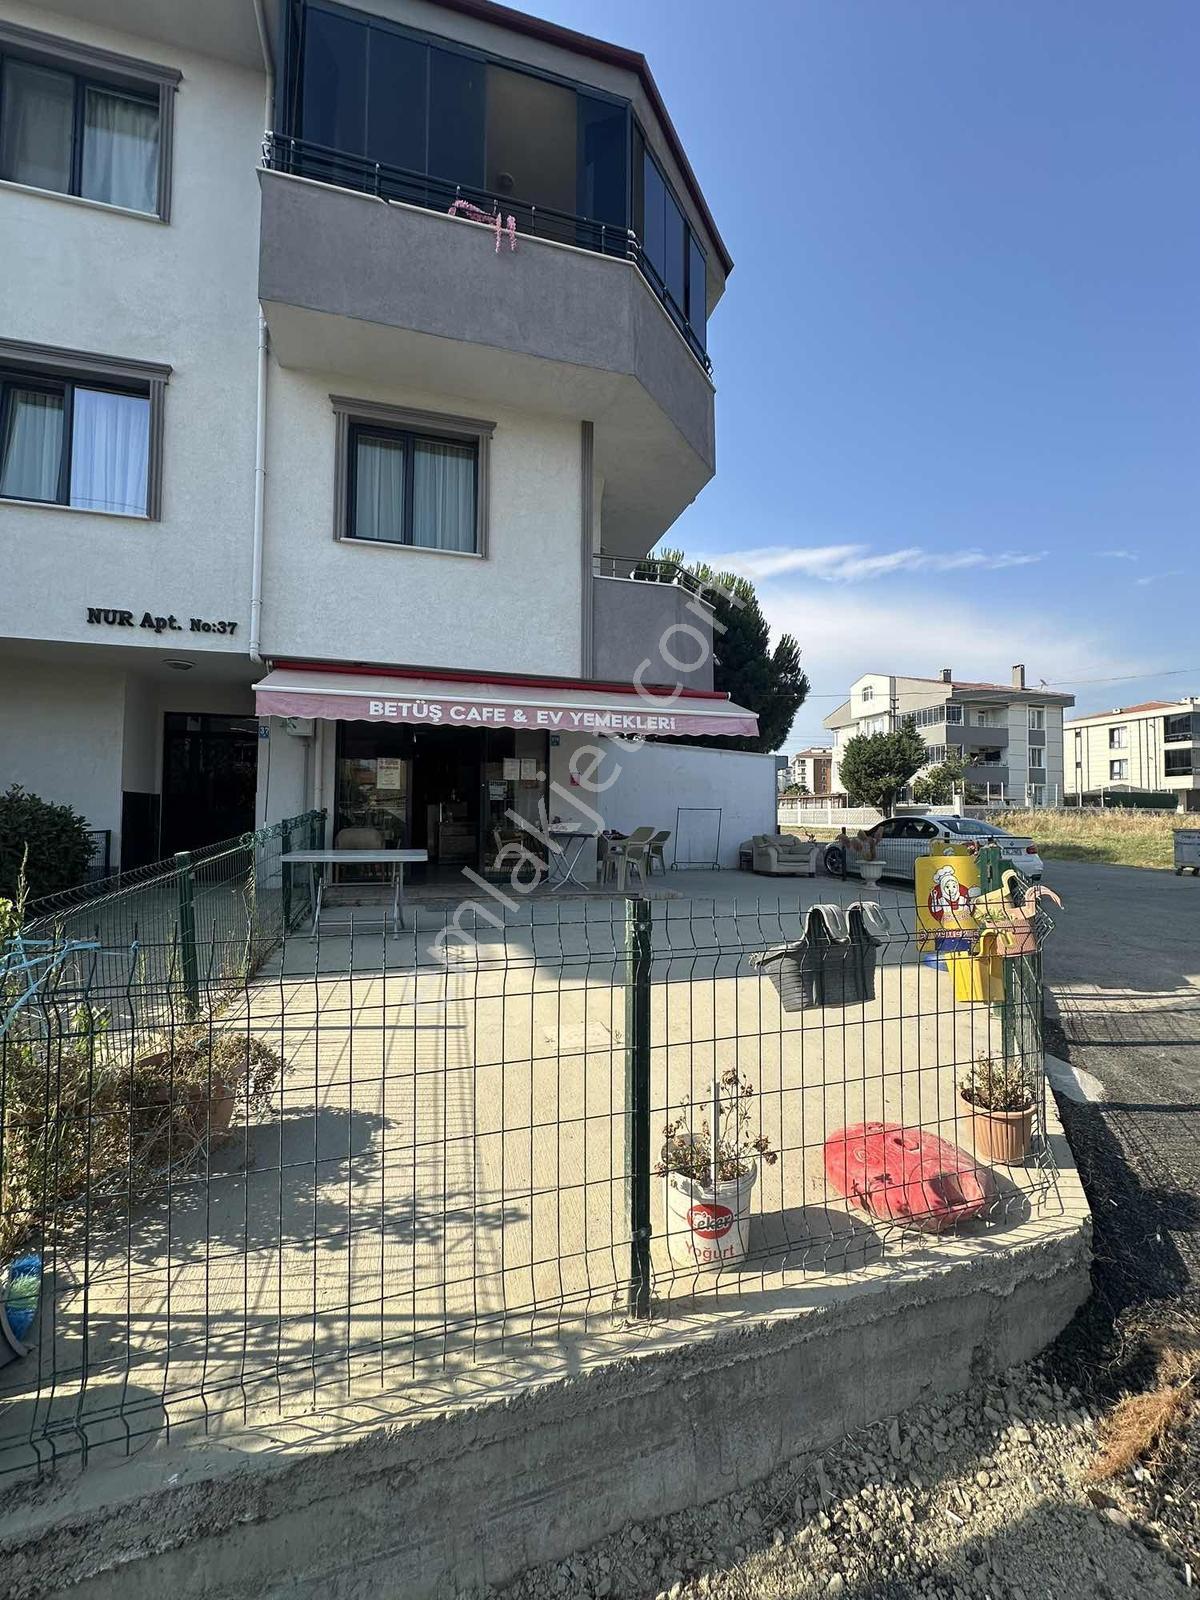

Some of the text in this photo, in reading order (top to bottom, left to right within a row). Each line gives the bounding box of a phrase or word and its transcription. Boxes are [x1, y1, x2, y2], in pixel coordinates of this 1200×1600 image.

[86, 607, 238, 635] NUR Apt. No:37
[368, 699, 442, 722] BETÜŞ
[449, 705, 506, 722] CAFE
[512, 709, 528, 723] &
[536, 710, 563, 724] EV
